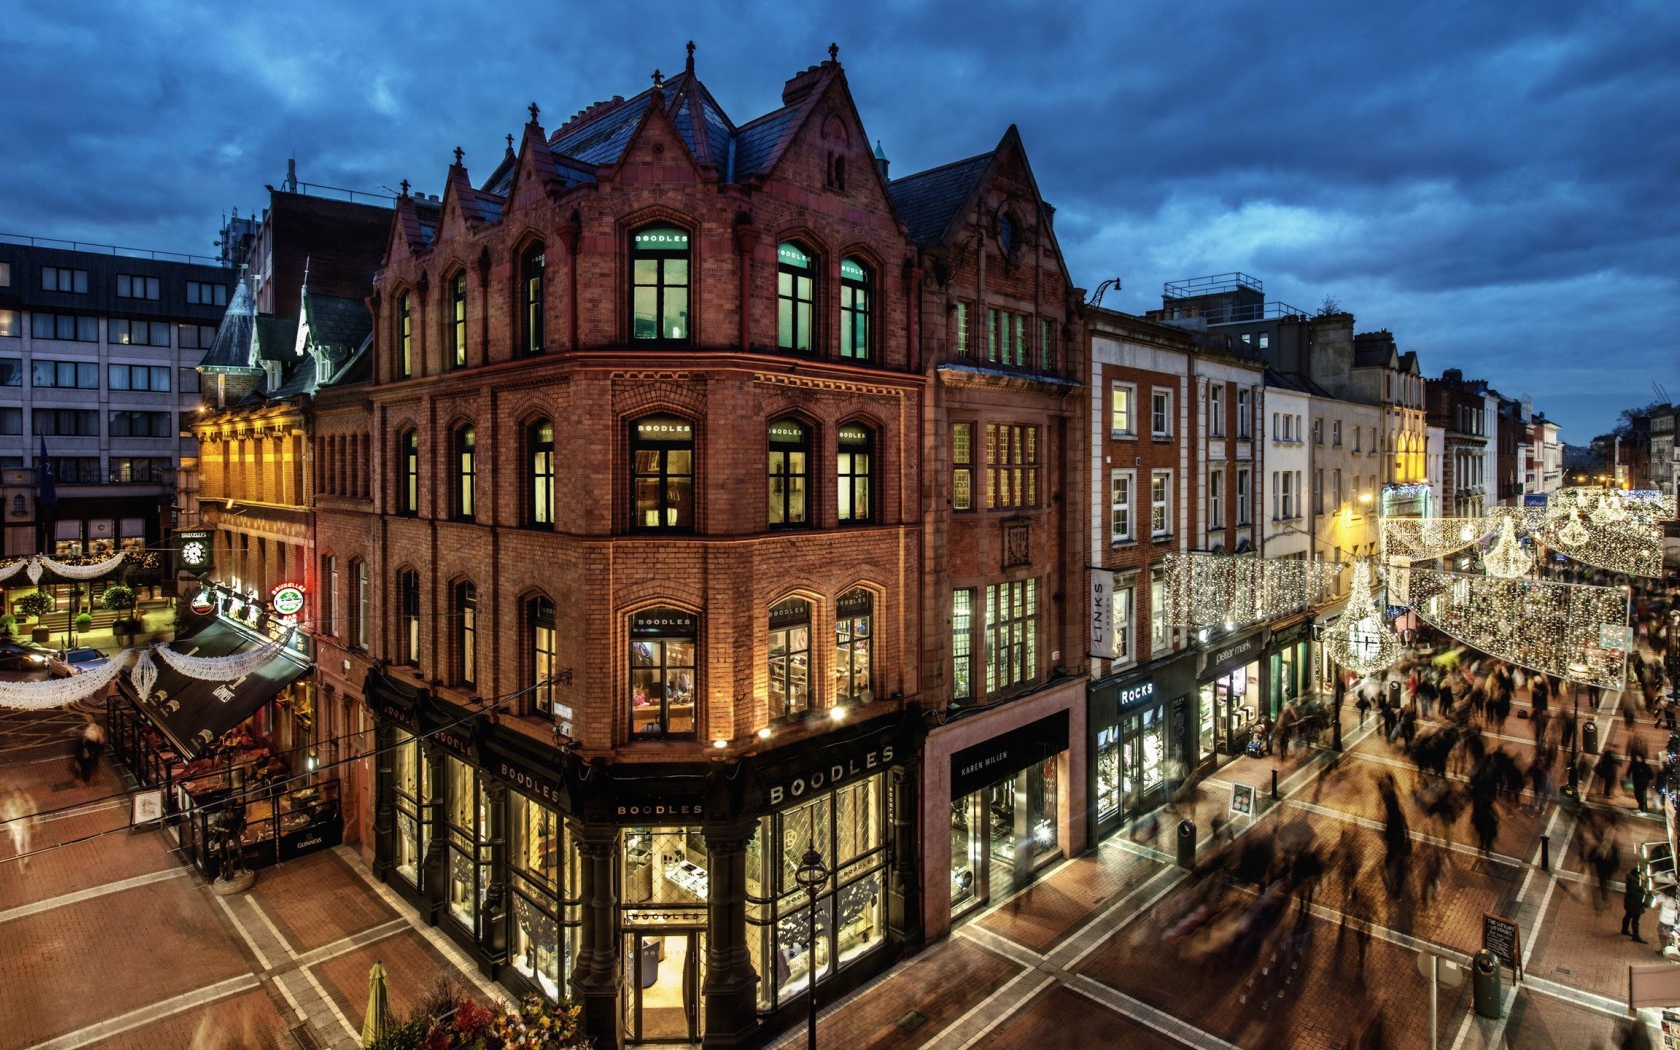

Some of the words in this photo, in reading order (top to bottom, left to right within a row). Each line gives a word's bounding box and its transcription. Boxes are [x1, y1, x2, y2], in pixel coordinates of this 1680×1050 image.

[271, 582, 306, 596] BRUXELLES
[1094, 583, 1103, 643] LINKS
[1216, 649, 1235, 666] peter
[1235, 639, 1251, 656] mark
[1121, 682, 1153, 705] ROCKS
[770, 746, 894, 805] BOODLES
[961, 761, 983, 777] KAREN
[985, 750, 1008, 766] MILLEN
[501, 763, 559, 803] BOODLES
[617, 805, 703, 815] BOODLES
[297, 837, 322, 849] GUINNESS
